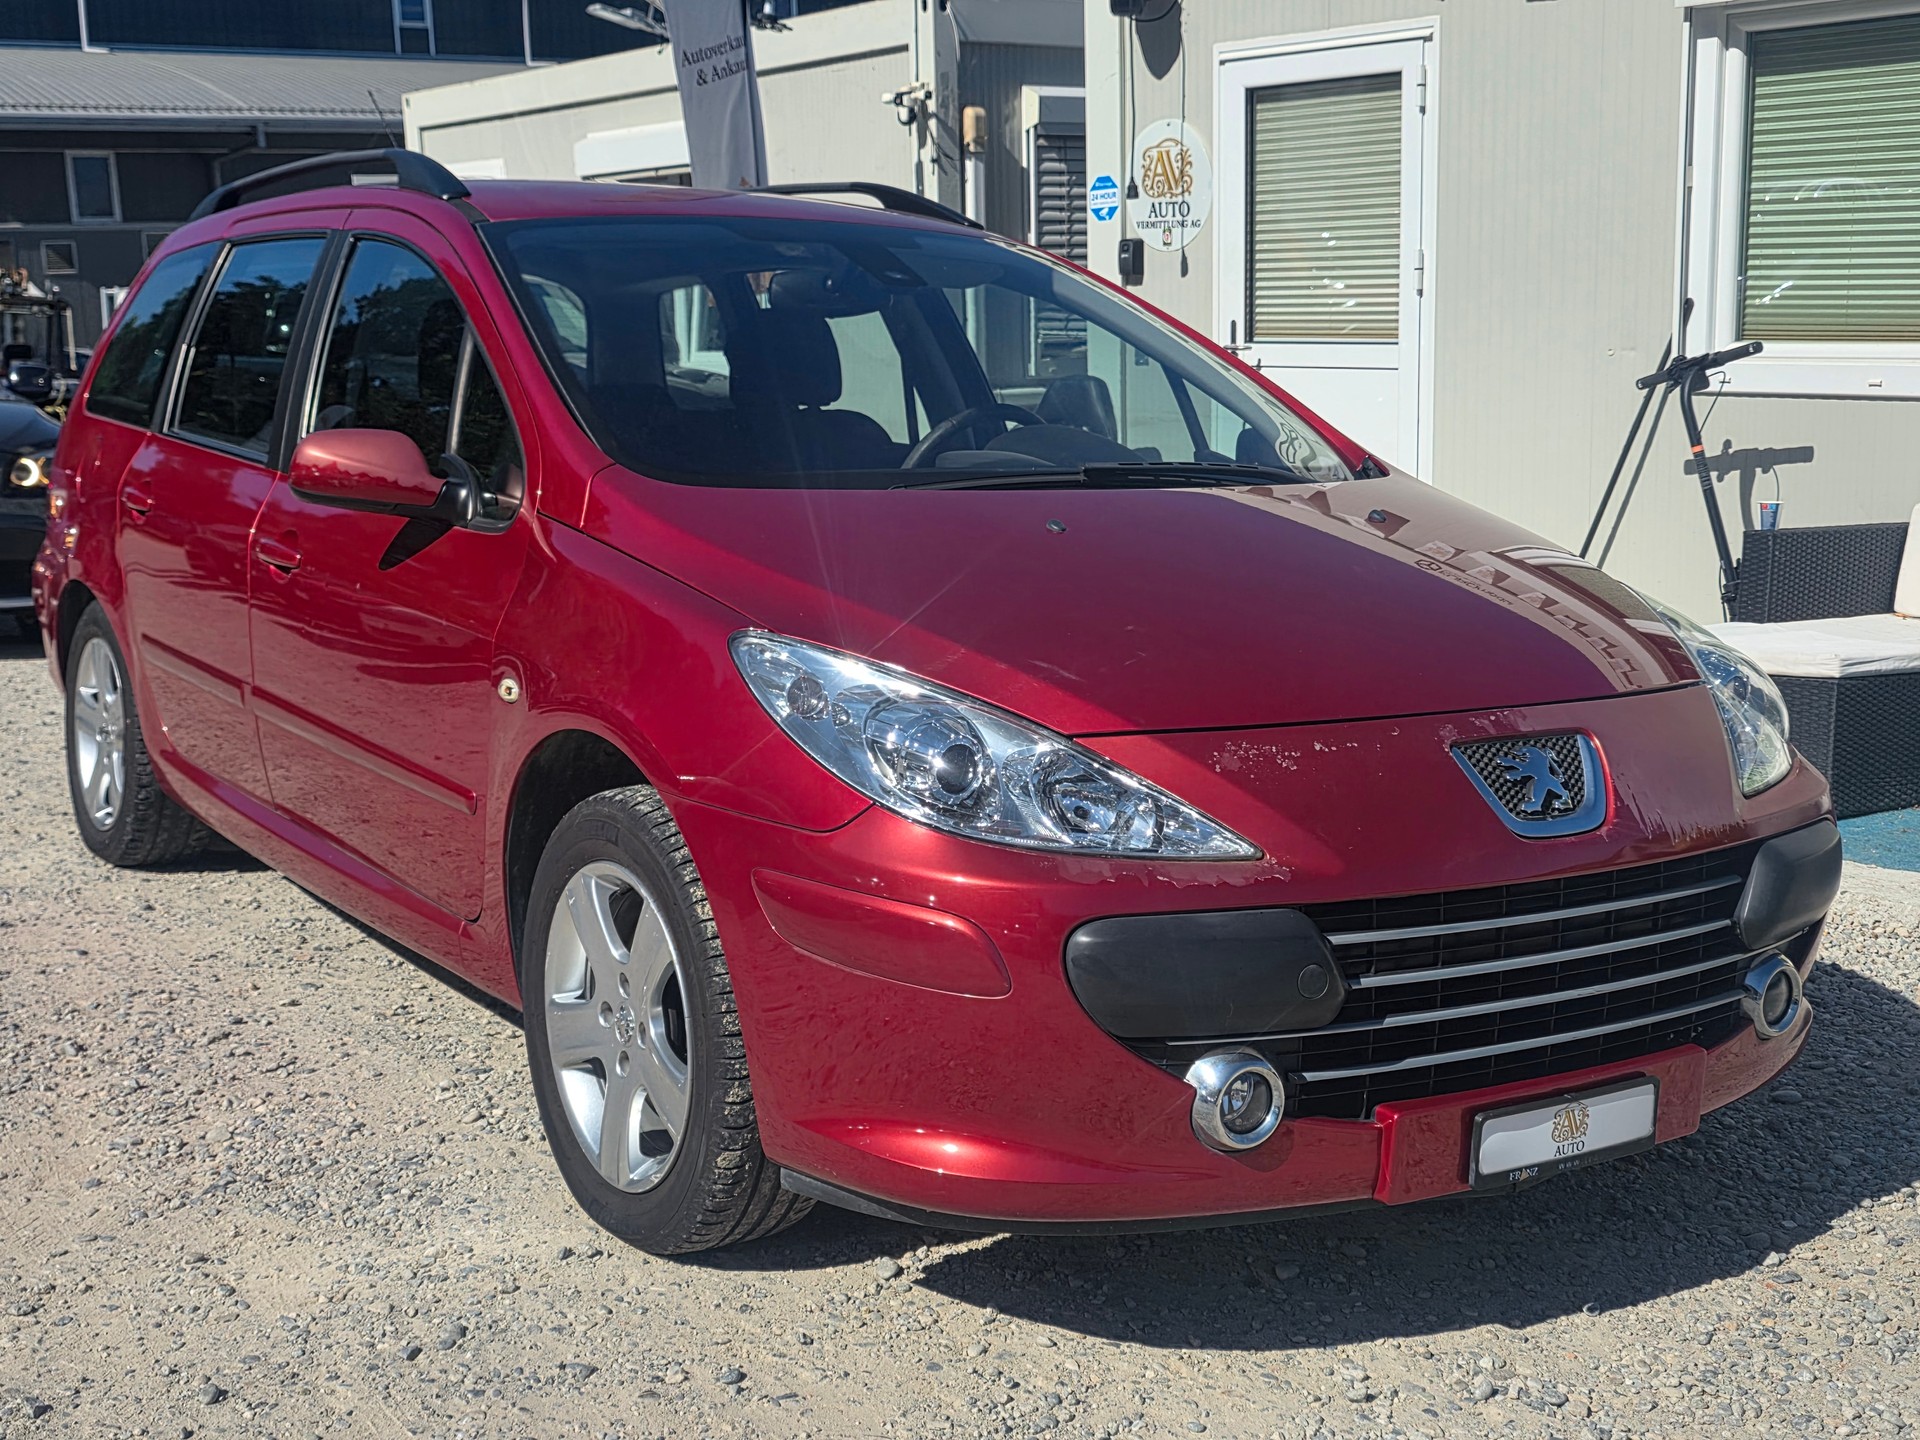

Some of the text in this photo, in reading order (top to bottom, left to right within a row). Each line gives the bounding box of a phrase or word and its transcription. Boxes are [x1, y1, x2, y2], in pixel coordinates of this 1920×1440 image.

[696, 68, 708, 87] &
[1091, 191, 1117, 201] 24 HOUR
[1148, 201, 1190, 218] AUTO
[1136, 219, 1201, 229] VERMITTLUNG AG
[1554, 1140, 1585, 1157] AUTO
